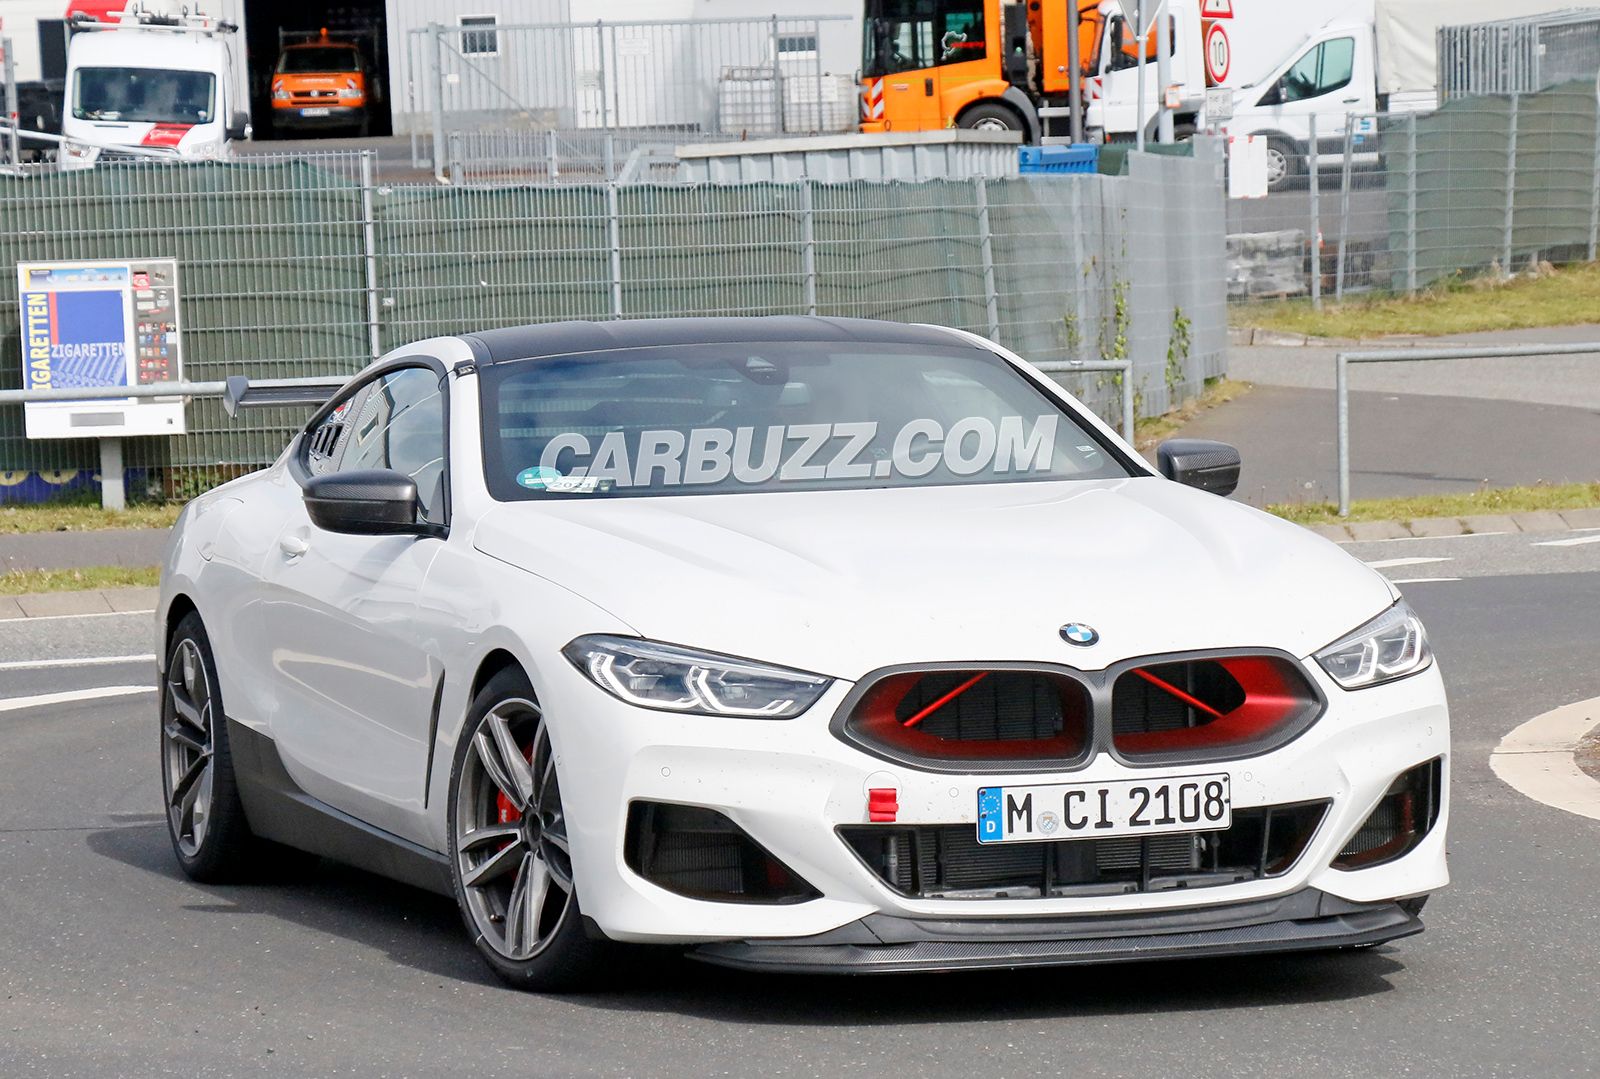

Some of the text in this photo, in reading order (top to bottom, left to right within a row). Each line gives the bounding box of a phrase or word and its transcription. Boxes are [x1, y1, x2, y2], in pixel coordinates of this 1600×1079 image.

[1212, 40, 1225, 67] 10
[27, 293, 53, 390] IGARETTEN
[985, 820, 996, 833] D
[1007, 780, 1225, 834] M CI 2108
